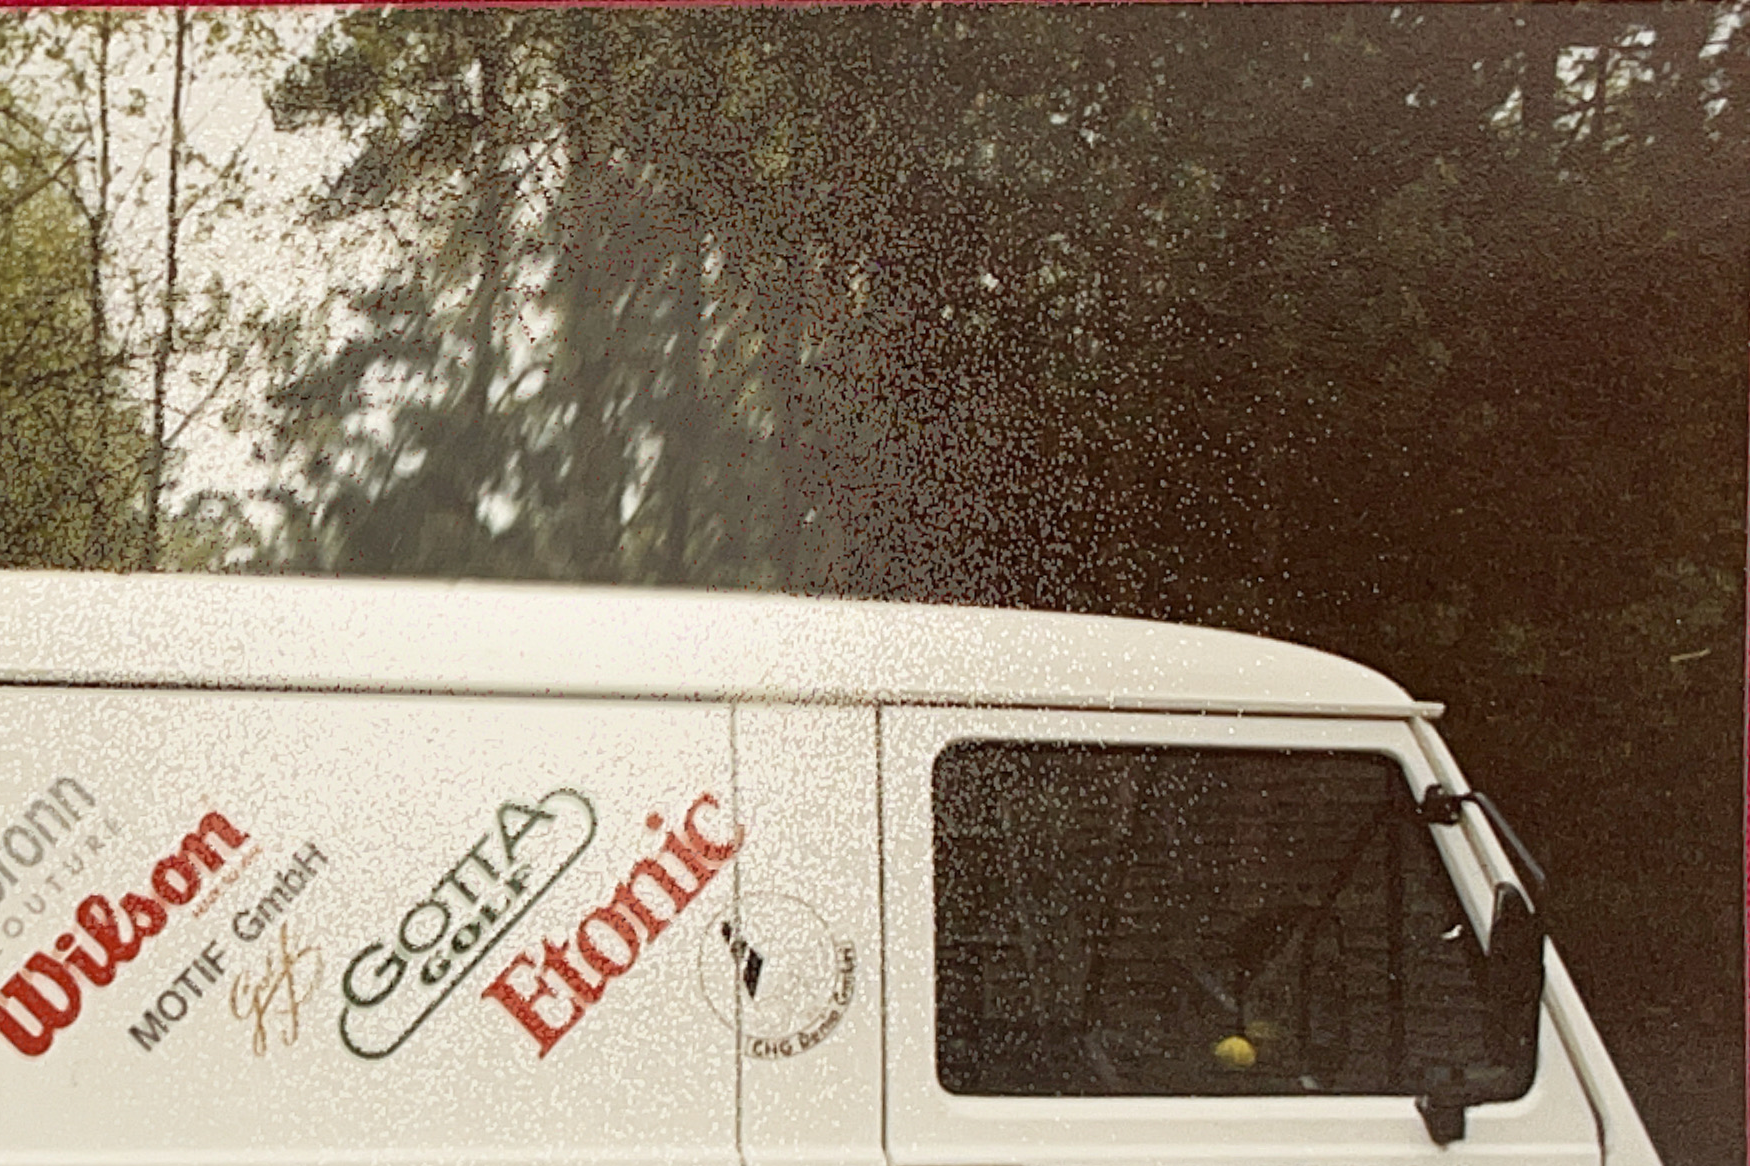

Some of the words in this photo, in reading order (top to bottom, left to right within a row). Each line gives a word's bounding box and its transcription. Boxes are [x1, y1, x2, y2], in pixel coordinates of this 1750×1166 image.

[128, 941, 226, 1052] MOTIF
[232, 842, 329, 941] GmbH
[342, 801, 557, 1007] GOTTA
[420, 864, 533, 985] GOLF
[480, 793, 745, 1060] Etonic
